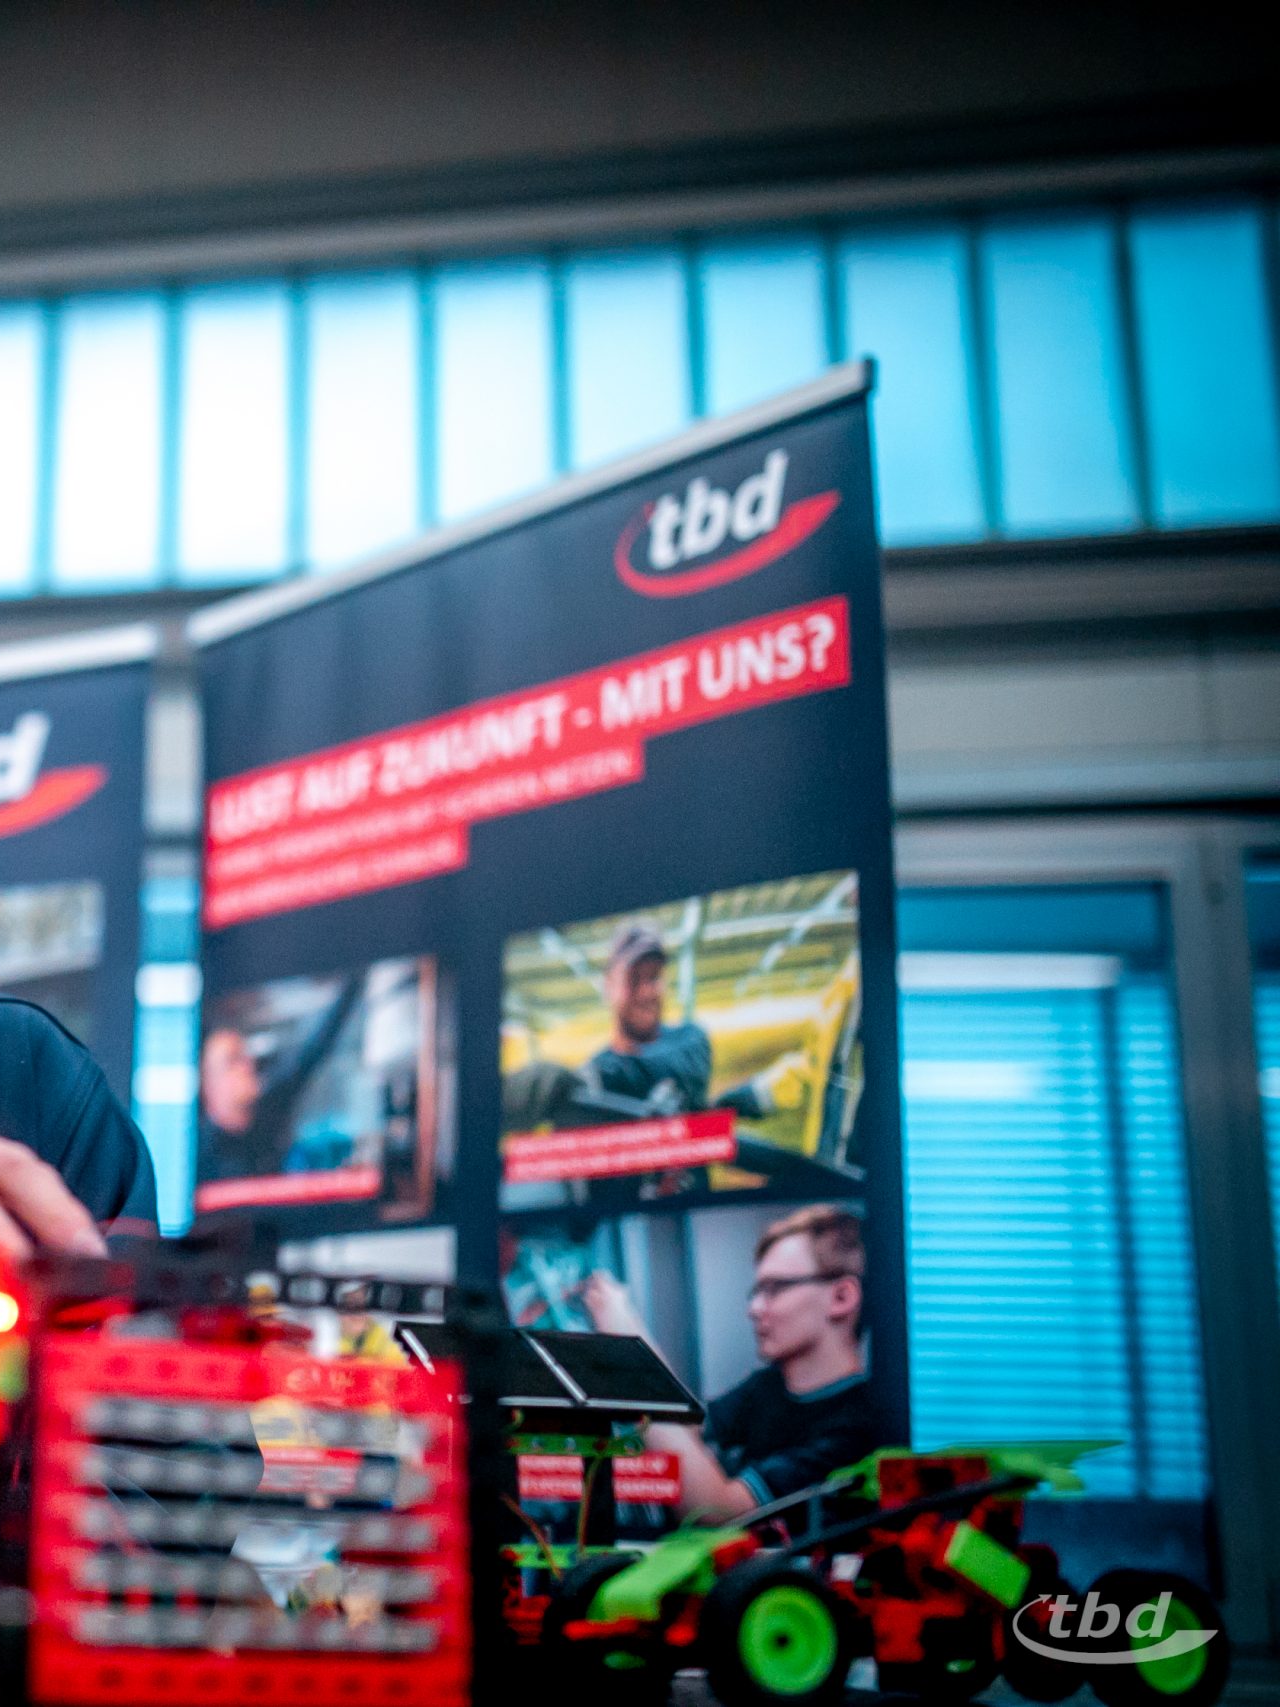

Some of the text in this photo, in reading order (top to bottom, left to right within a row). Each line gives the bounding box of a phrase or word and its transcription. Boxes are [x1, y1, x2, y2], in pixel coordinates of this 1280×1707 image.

[649, 449, 788, 569] tbd
[297, 748, 372, 815] AUF
[378, 693, 566, 797] ZUKUNFT
[600, 654, 692, 732] MIT
[697, 613, 836, 700] UNS?
